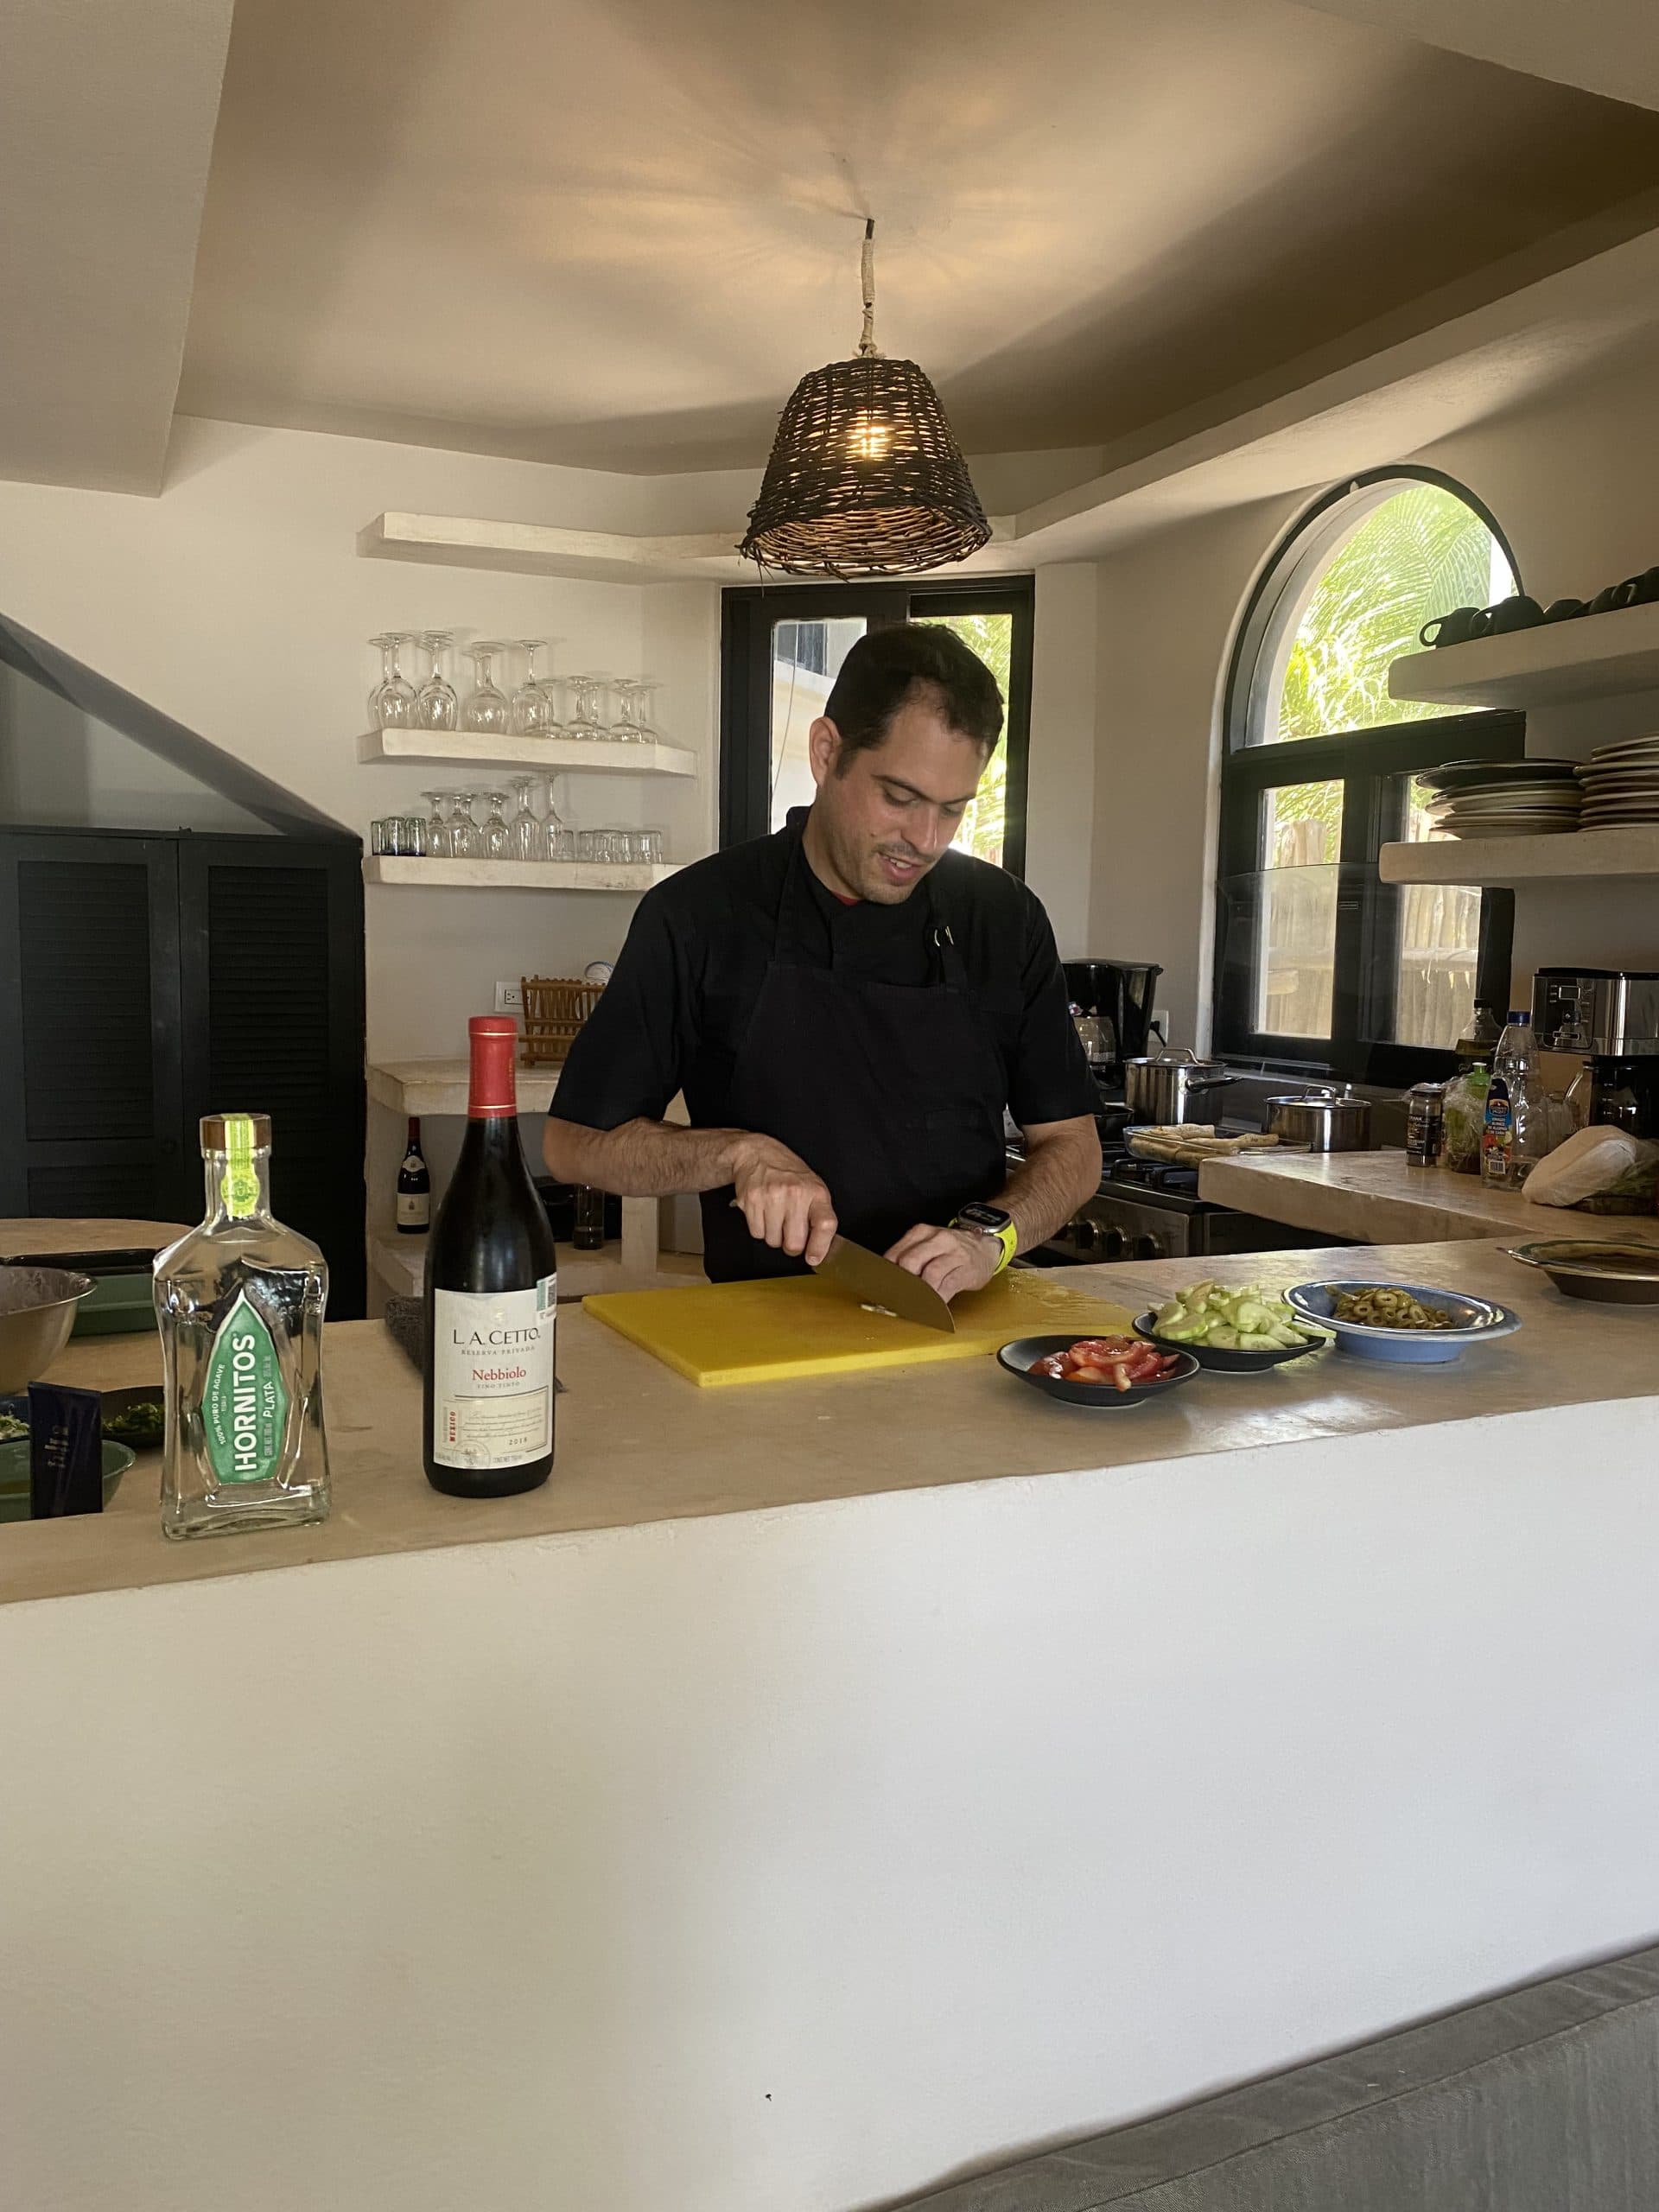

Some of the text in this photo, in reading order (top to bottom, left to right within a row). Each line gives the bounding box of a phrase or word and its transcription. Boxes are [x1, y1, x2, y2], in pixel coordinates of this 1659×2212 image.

[489, 1327, 539, 1344] CETTO
[501, 1344, 536, 1355] PRIVADA
[213, 1363, 226, 1389] AGAVE
[473, 1366, 526, 1381] Nebbiolo
[213, 1391, 219, 1402] DE
[232, 1334, 257, 1471] HORNITOS
[263, 1382, 276, 1418] PLATA
[215, 1426, 226, 1445] 100%
